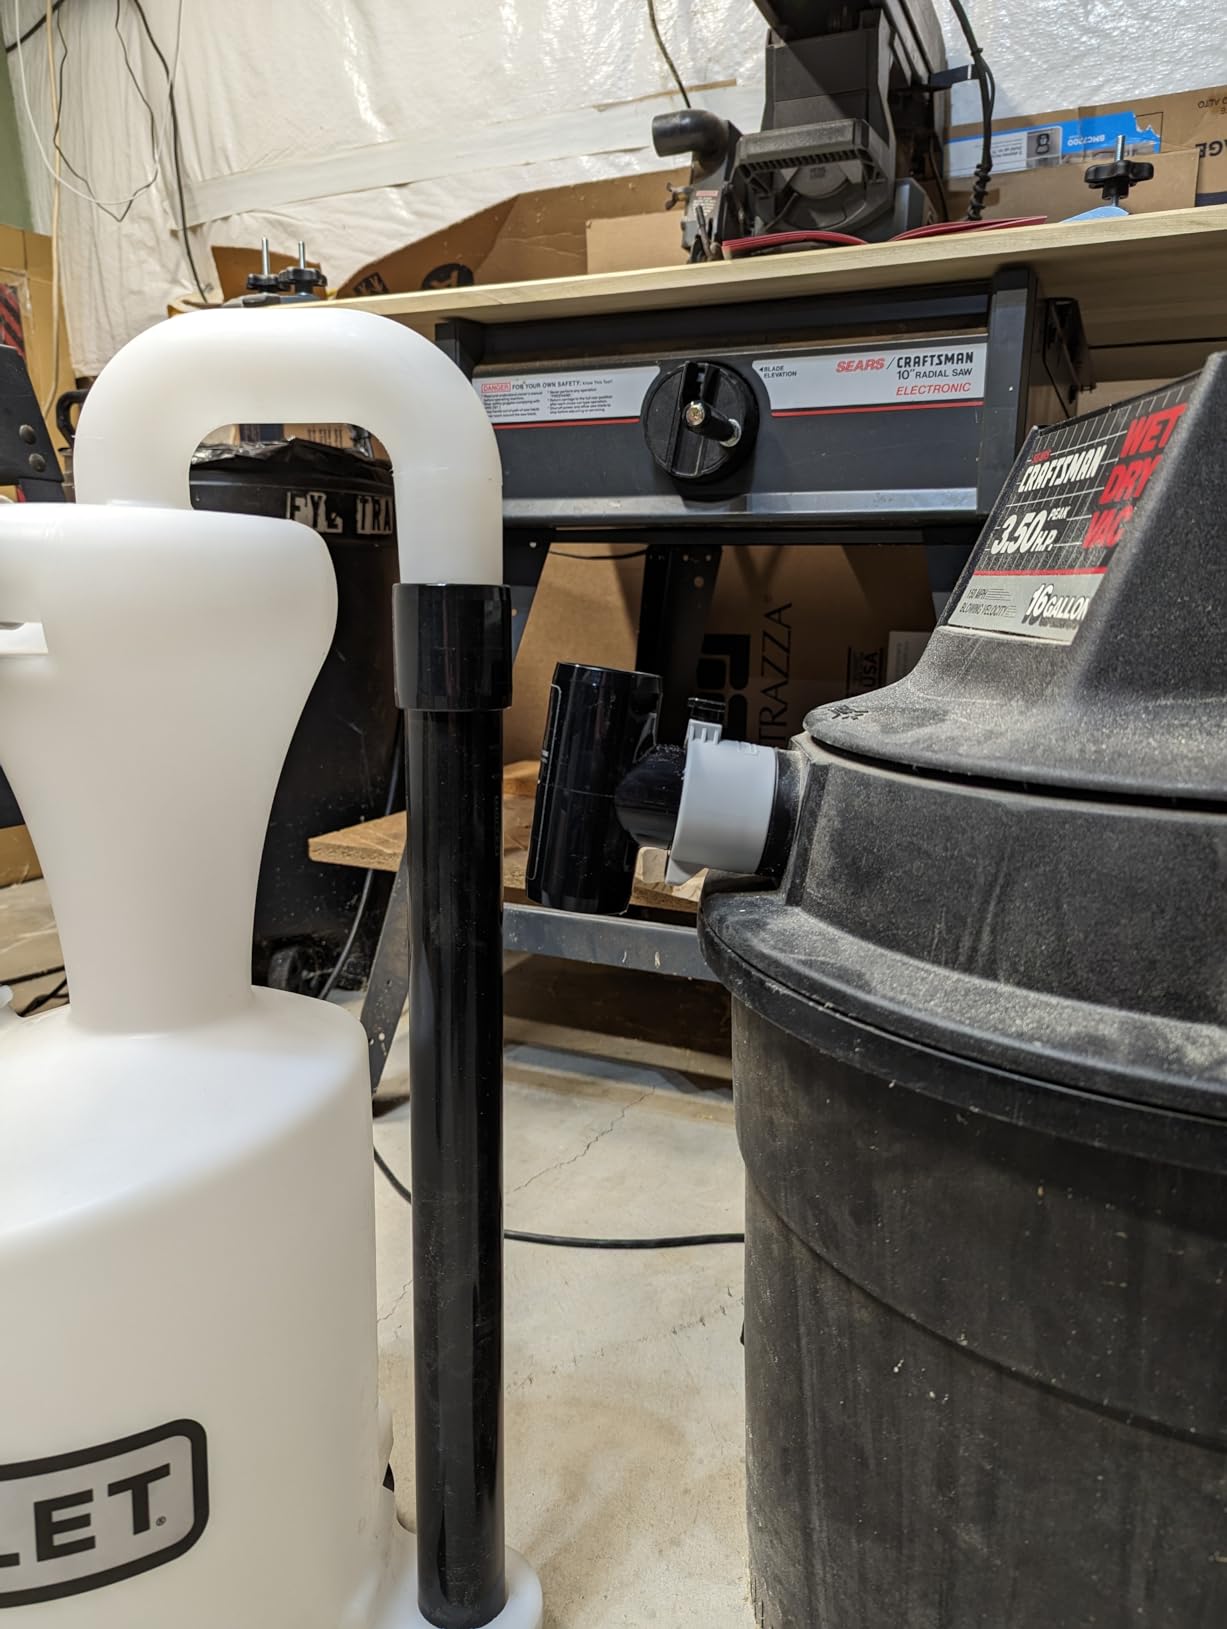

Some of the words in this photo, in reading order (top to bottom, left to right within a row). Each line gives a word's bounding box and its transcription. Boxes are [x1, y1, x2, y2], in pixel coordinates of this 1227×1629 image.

[763, 371, 797, 379] ELEVATION
[835, 357, 886, 373] SEARS
[896, 351, 974, 369] CRAFTSMAN
[915, 369, 950, 379] RADIAL
[951, 368, 973, 377] SAW
[896, 382, 972, 396] ELECTRONIC
[1120, 403, 1187, 457] WET
[1018, 444, 1108, 493] CRAFTSMAN
[1098, 455, 1163, 505] DRY
[1047, 506, 1072, 520] PEAK
[1082, 507, 1133, 549] VAC
[990, 510, 1048, 555] 3.50
[1025, 584, 1054, 617] 16
[1042, 594, 1090, 621] GALLON
[863, 651, 879, 688] USA
[0, 1462, 171, 1568] ET
